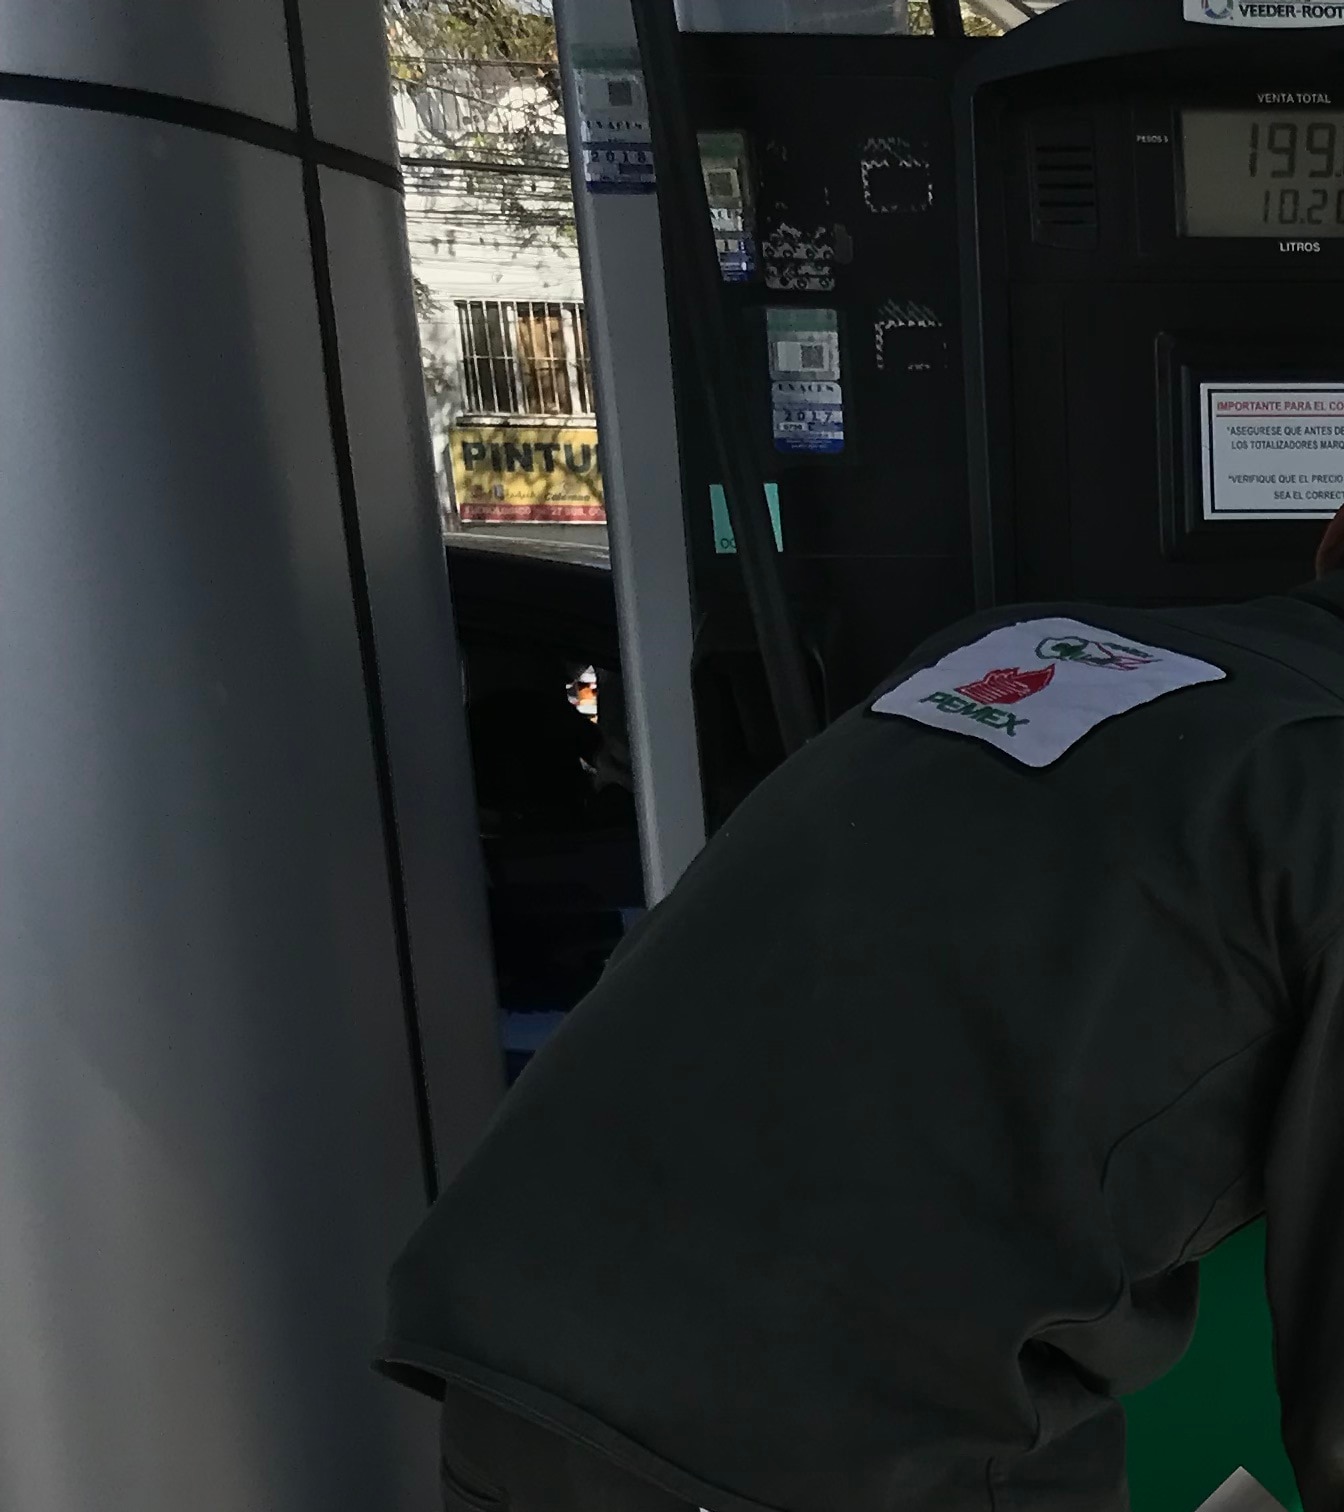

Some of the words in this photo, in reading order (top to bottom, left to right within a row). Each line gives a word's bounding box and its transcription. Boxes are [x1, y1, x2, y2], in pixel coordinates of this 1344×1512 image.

[1239, 4, 1344, 19] VEEDER-ROOT
[1257, 93, 1294, 104] VENTA
[1297, 93, 1331, 104] TOTAL
[1279, 242, 1321, 253] LITROS
[1217, 401, 1282, 411] IMPORTANTE
[1284, 401, 1312, 411] PARA
[1314, 401, 1326, 411] EL
[1284, 426, 1301, 436] QUE
[1304, 426, 1332, 436] ANTES
[1231, 440, 1248, 450] LOS
[1250, 440, 1318, 450] TOTALIZADORES
[462, 441, 600, 473] PINTU
[1279, 475, 1296, 484] QUE
[1299, 475, 1309, 484] EL
[1312, 475, 1343, 484] PRECIO
[1274, 491, 1290, 500] SEA
[1293, 491, 1303, 500] EL
[920, 691, 1030, 738] PEMEX
